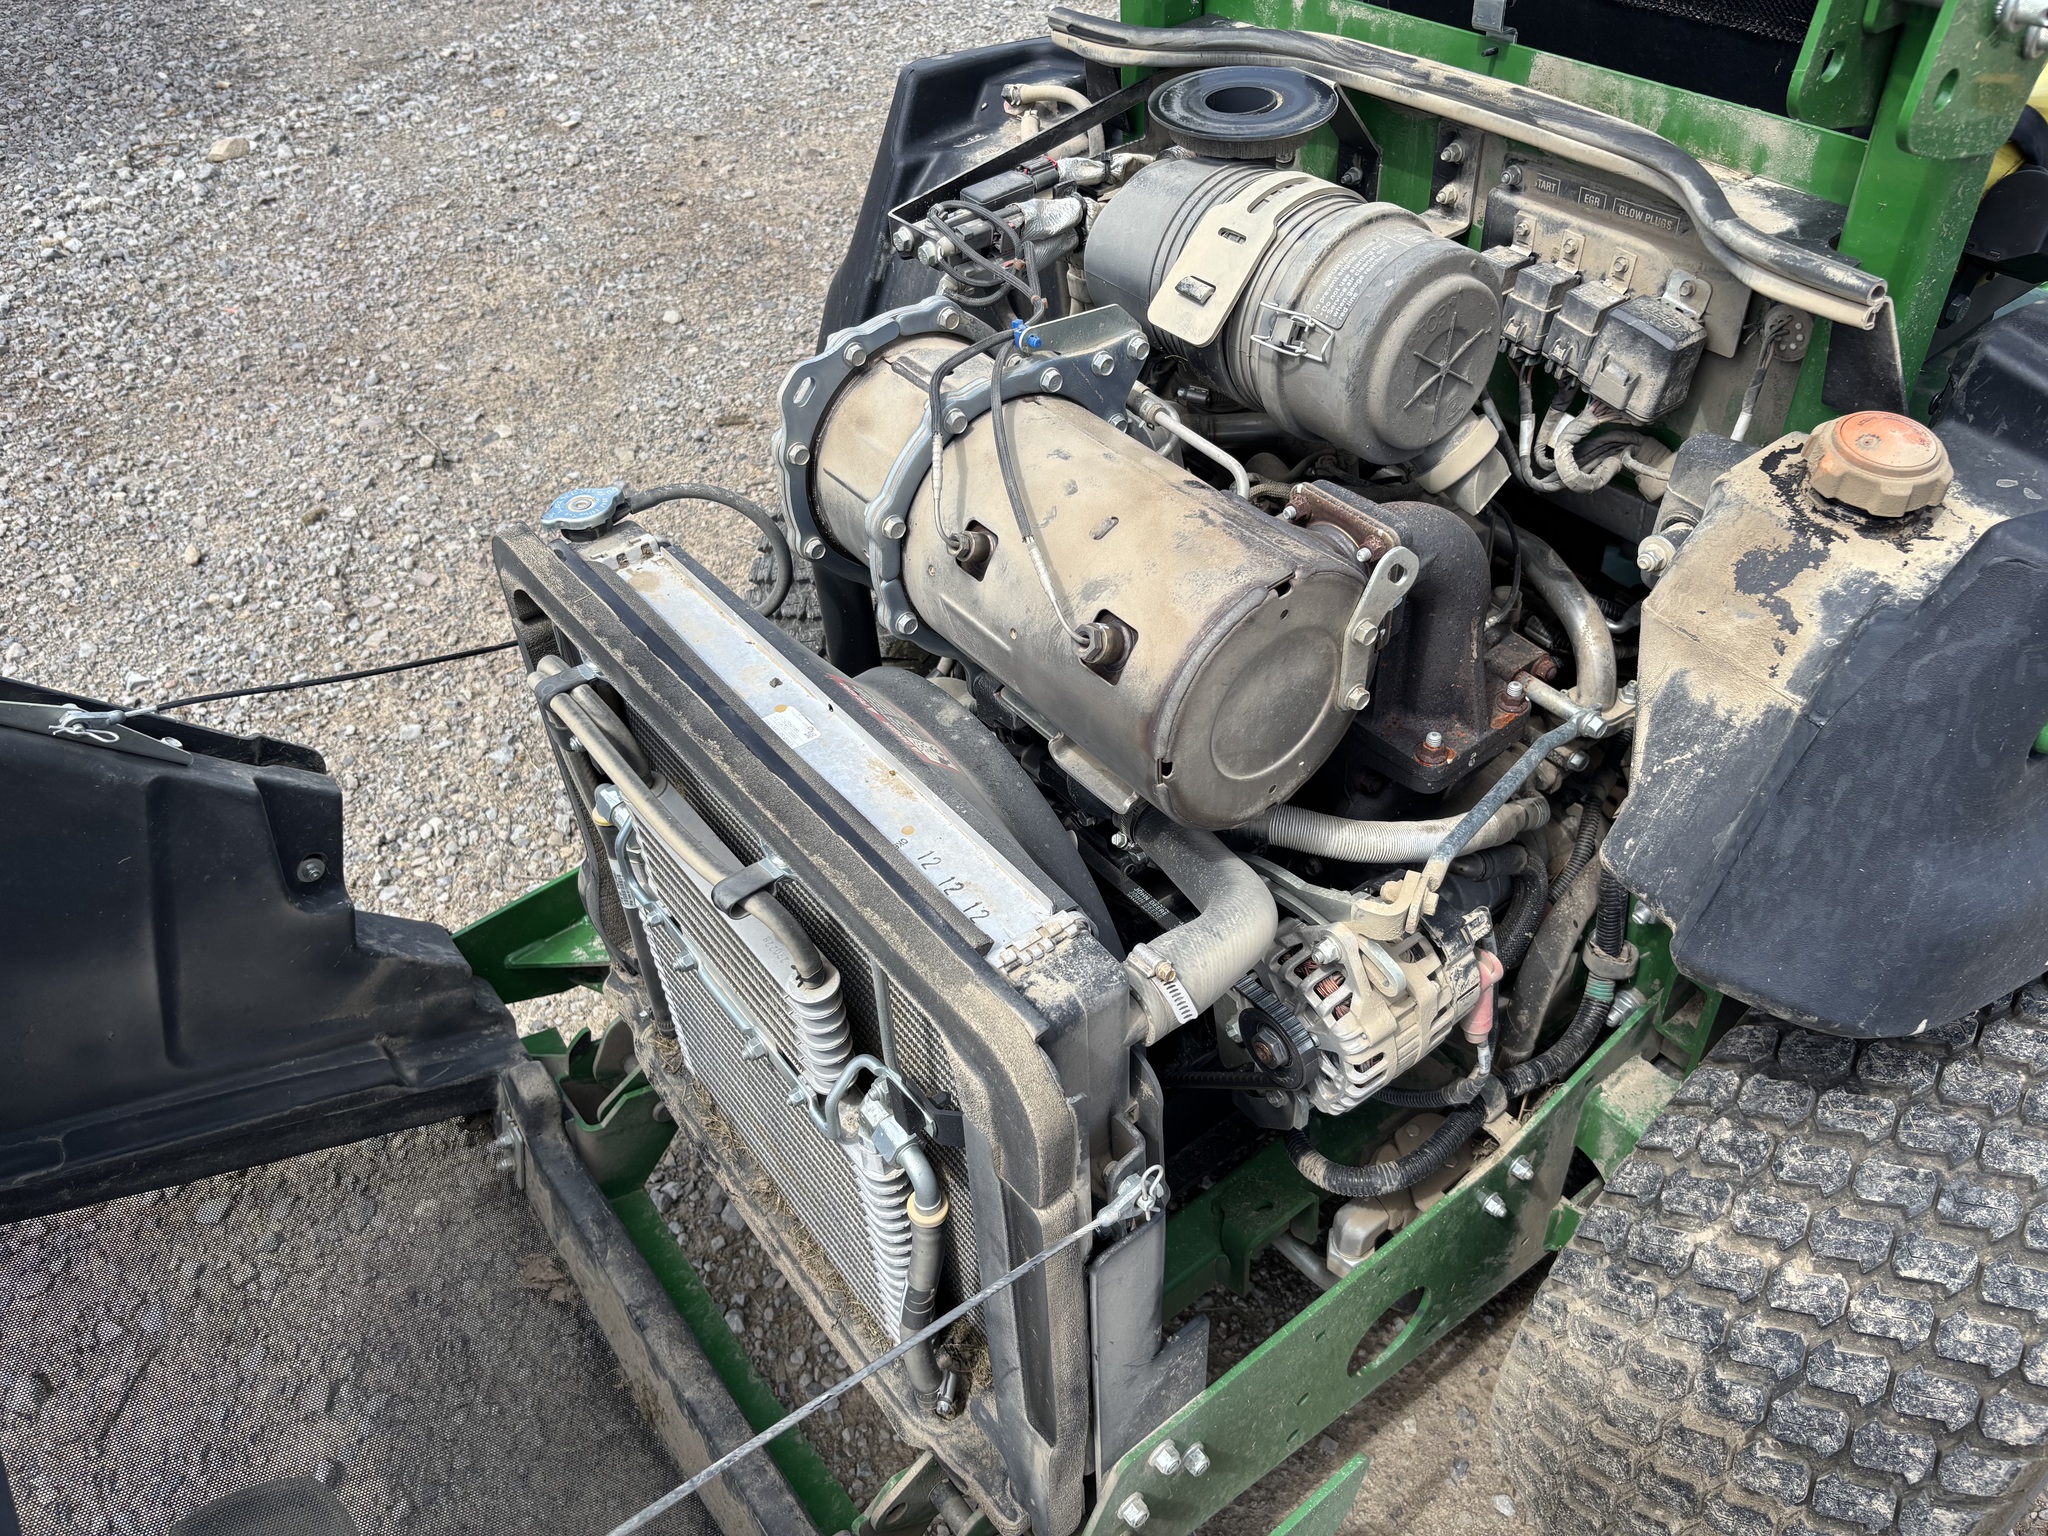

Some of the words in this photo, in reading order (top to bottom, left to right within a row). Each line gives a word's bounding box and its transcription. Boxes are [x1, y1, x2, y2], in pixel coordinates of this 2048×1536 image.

[1583, 193, 1601, 207] EGR
[1618, 205, 1644, 220] GLOW
[1644, 213, 1673, 230] PLUGS
[1312, 304, 1320, 313] To
[1320, 276, 1339, 304] prevent
[1337, 255, 1357, 276] engine
[1321, 301, 1331, 312] Do
[1330, 287, 1340, 300] not
[1339, 273, 1350, 287] use
[1349, 250, 1374, 273] starting
[1322, 249, 1355, 287] IMPORTANT
[1326, 287, 1347, 315] Service
[1346, 276, 1355, 287] air
[1354, 254, 1376, 277] cleaner
[1333, 297, 1348, 317] when
[1346, 275, 1364, 297] gauge
[1363, 252, 1388, 275] reaches
[1338, 307, 1348, 320] red
[1346, 292, 1358, 307] line
[917, 850, 942, 870] 12
[938, 876, 964, 896] 12
[963, 901, 990, 924] 12
[1129, 891, 1145, 904] JOHN
[1143, 903, 1163, 919] DEERE
[1133, 887, 1150, 901] JOHN
[1149, 899, 1169, 916] DEERE
